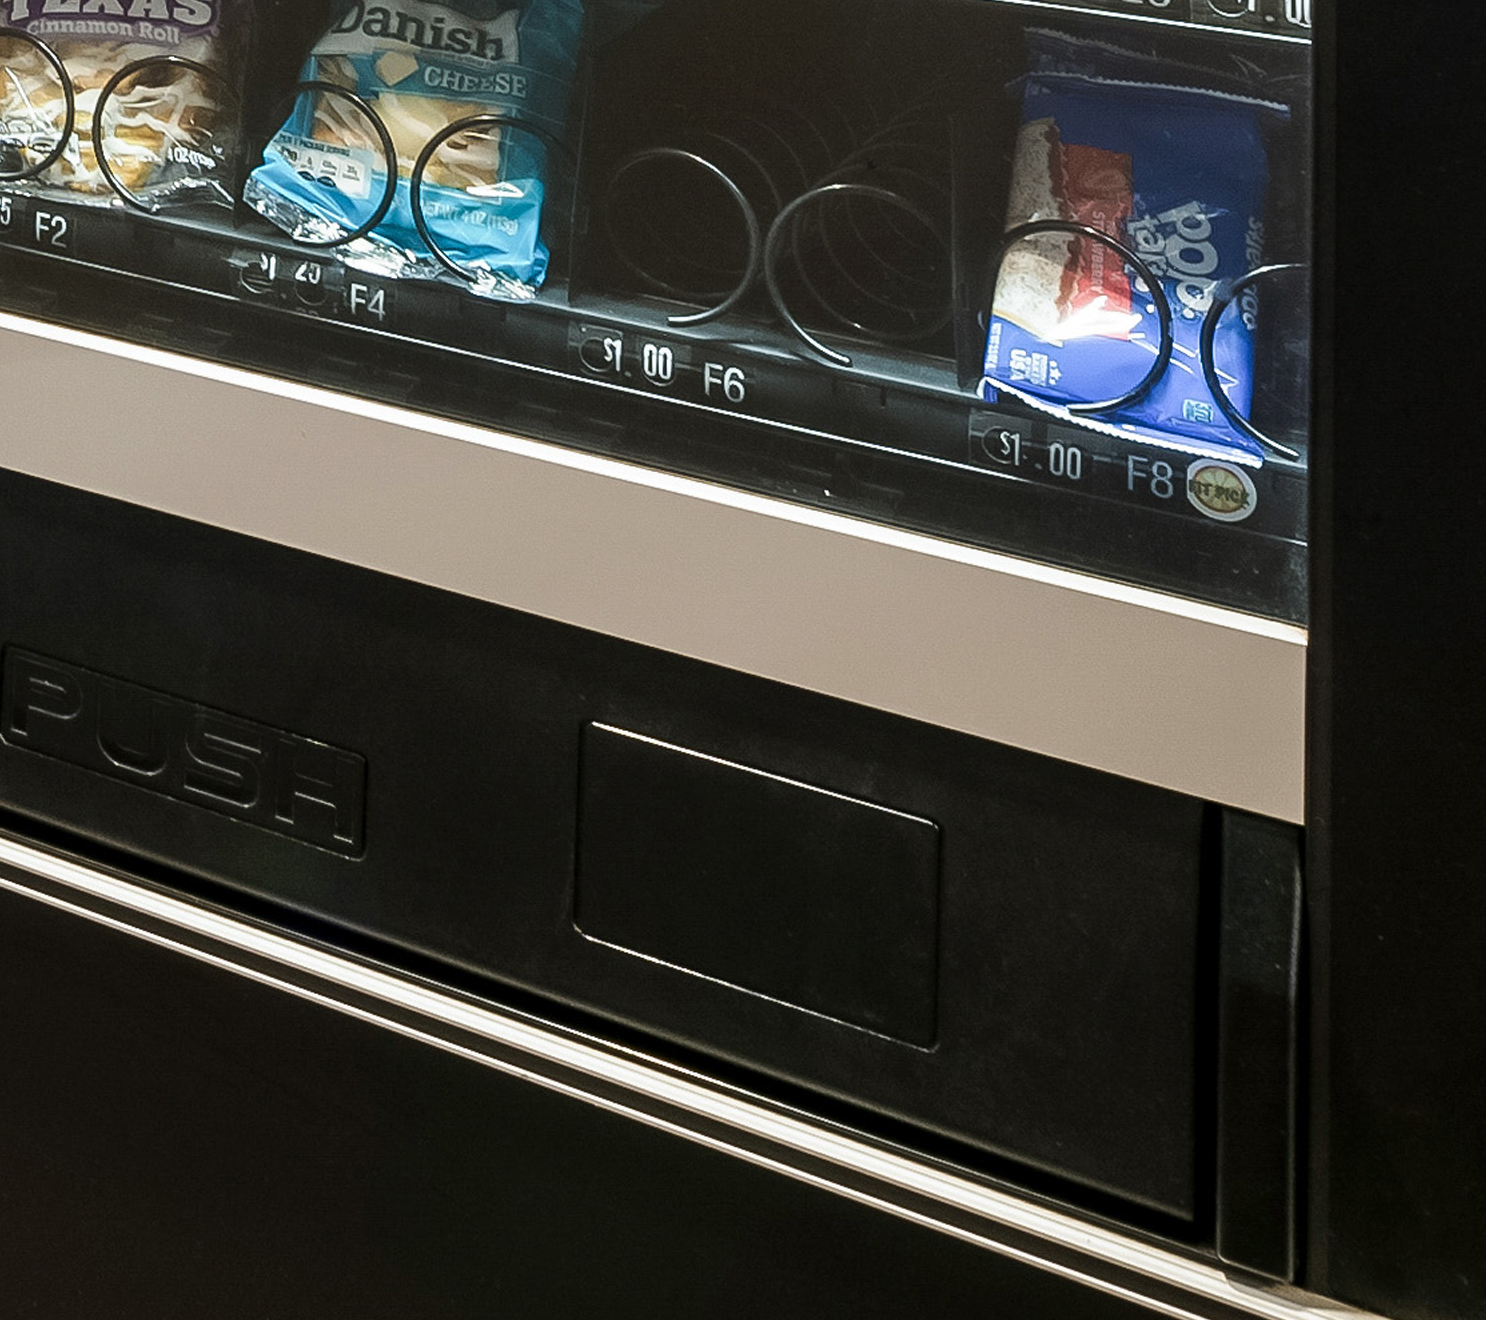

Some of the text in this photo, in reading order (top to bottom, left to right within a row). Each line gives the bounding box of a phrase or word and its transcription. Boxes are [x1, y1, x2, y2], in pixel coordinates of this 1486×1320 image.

[137, 21, 182, 45] Roll
[331, 0, 505, 61] Danish
[424, 65, 527, 97] CHEESE
[36, 211, 67, 248] F2
[350, 283, 386, 321] F4
[703, 363, 745, 402] F6
[1128, 455, 1174, 499] F8
[8, 649, 358, 844] PUSH
